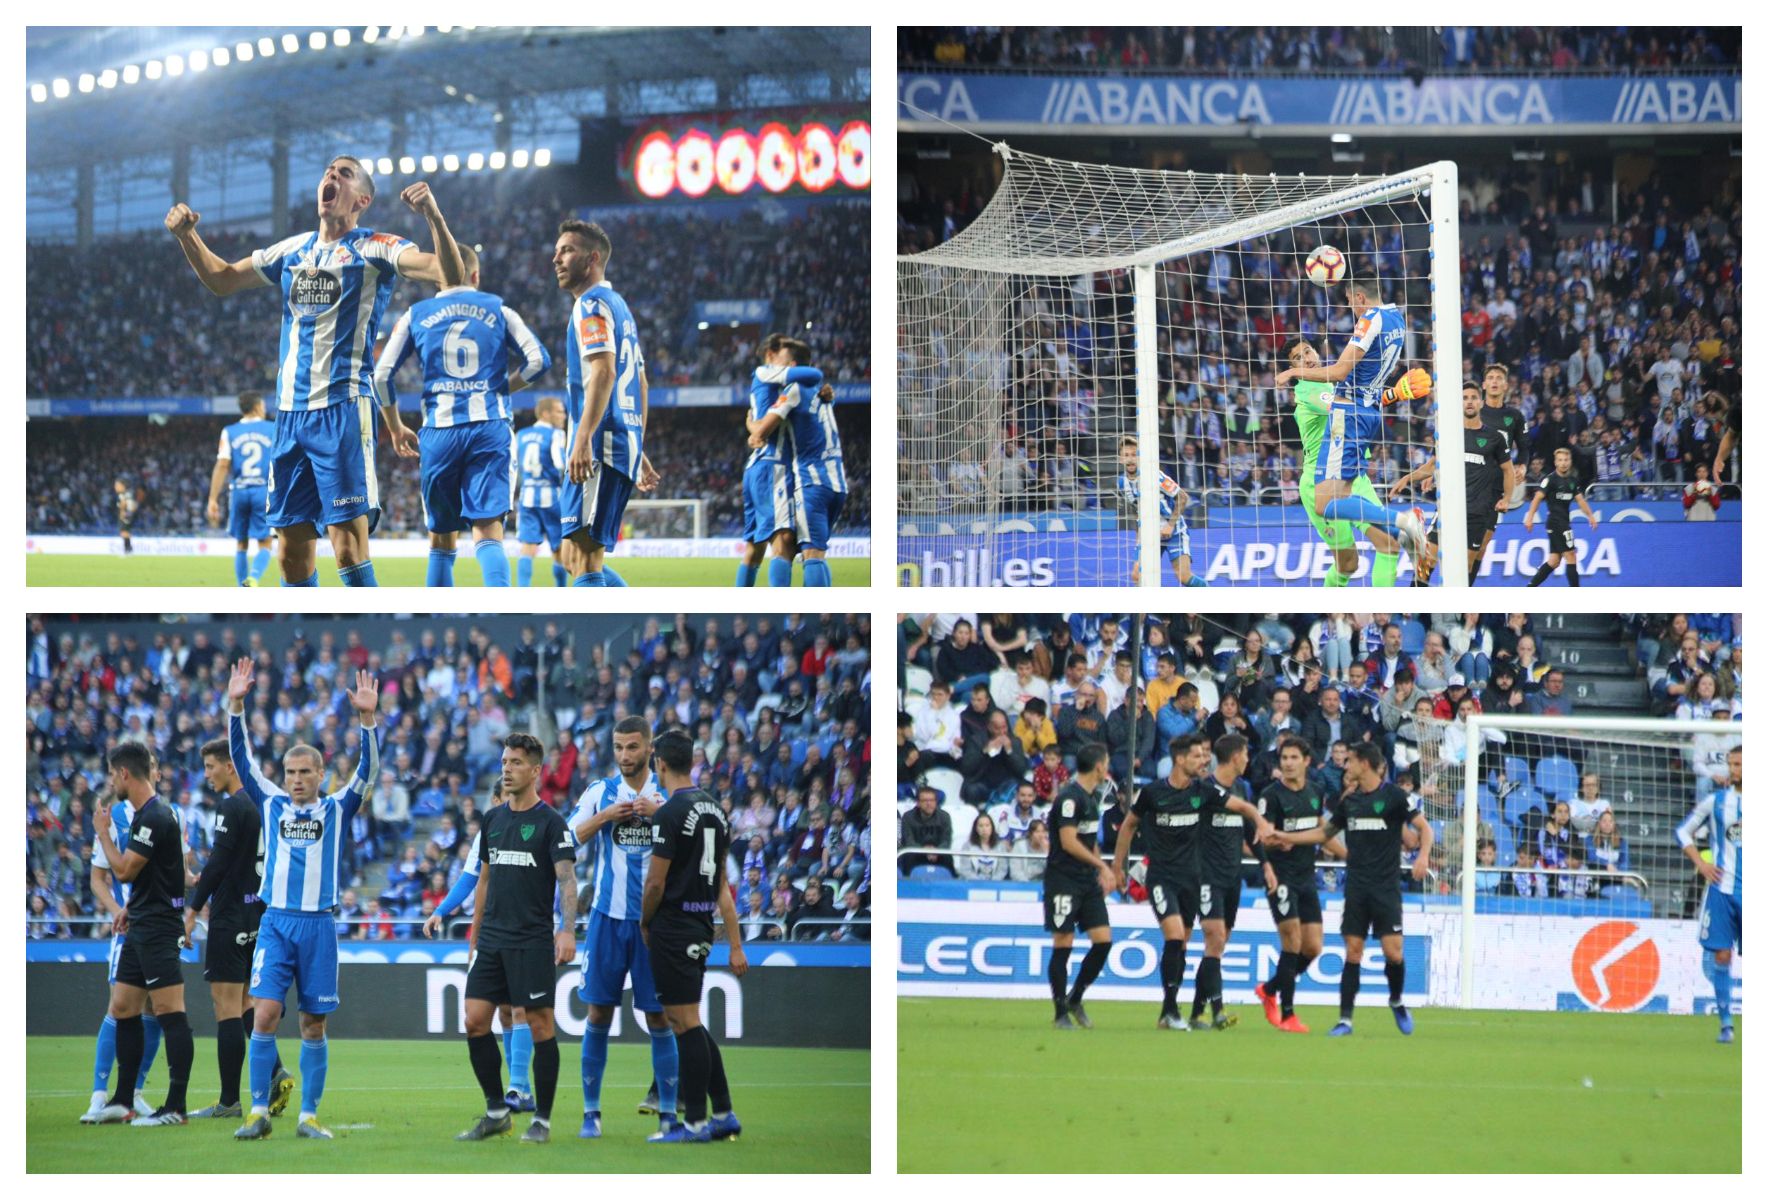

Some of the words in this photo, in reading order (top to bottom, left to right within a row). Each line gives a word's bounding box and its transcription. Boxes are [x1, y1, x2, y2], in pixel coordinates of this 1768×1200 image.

[897, 77, 979, 122] CA
[297, 277, 334, 291] Estrella
[297, 291, 330, 304] Galicia
[420, 303, 487, 329] DOMINGOS
[442, 320, 480, 380] 6
[240, 441, 263, 478] 2
[523, 443, 543, 478] 4
[333, 495, 365, 507] macron
[1560, 650, 1580, 664] 10
[1577, 685, 1588, 698] 9
[681, 810, 700, 837] LUIS
[284, 829, 316, 840] Galicia
[699, 827, 717, 886] 4
[1200, 884, 1211, 903] 5
[1277, 884, 1288, 902] 9
[1053, 895, 1072, 916] 15
